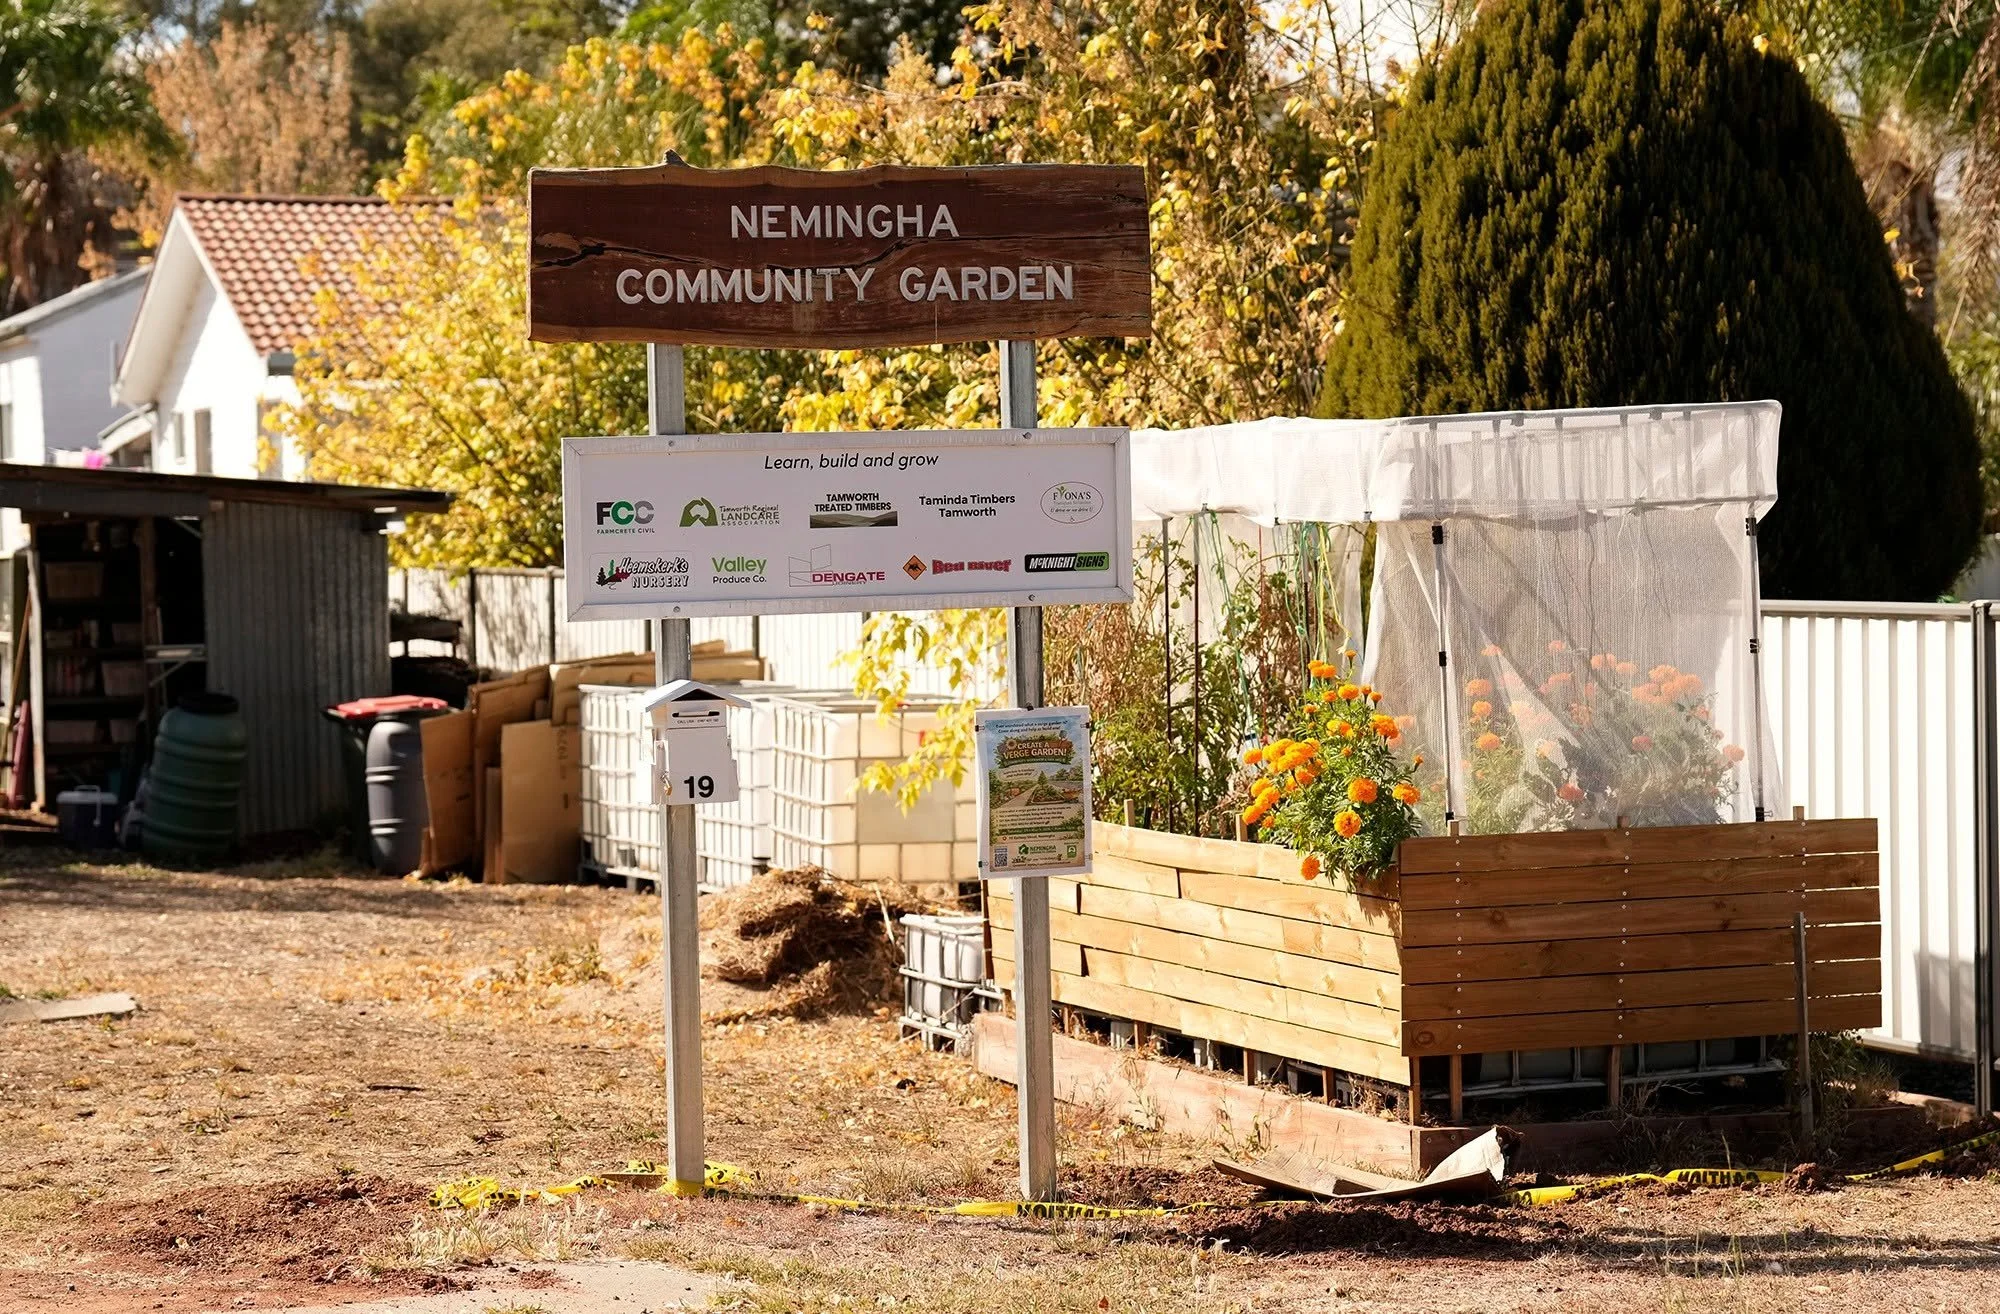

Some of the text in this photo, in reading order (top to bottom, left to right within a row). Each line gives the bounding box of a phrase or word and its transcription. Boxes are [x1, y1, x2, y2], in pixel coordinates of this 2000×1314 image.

[731, 203, 959, 239] NEMINGHA
[616, 265, 1073, 305] COMMUNITY GARDEN
[764, 452, 939, 471] Learn, build and grow
[826, 492, 880, 503] TAMWORTH
[919, 494, 1016, 506] Taminda Timbers
[596, 500, 655, 526] FCC
[752, 504, 779, 513] Regional
[814, 502, 892, 512] TREATED TIMBERS
[939, 507, 996, 518] Tamworth
[721, 512, 780, 521] LANDCARE
[618, 557, 690, 574] Heemskerk's
[712, 556, 768, 574] Valley
[1076, 555, 1106, 568] SIGNS
[631, 575, 690, 589] NURSERY
[712, 575, 767, 584] Produce Co.
[812, 572, 885, 582] DENGATE
[1017, 742, 1042, 750] CREATE
[1004, 750, 1030, 759] VERGE
[684, 775, 715, 798] 19
